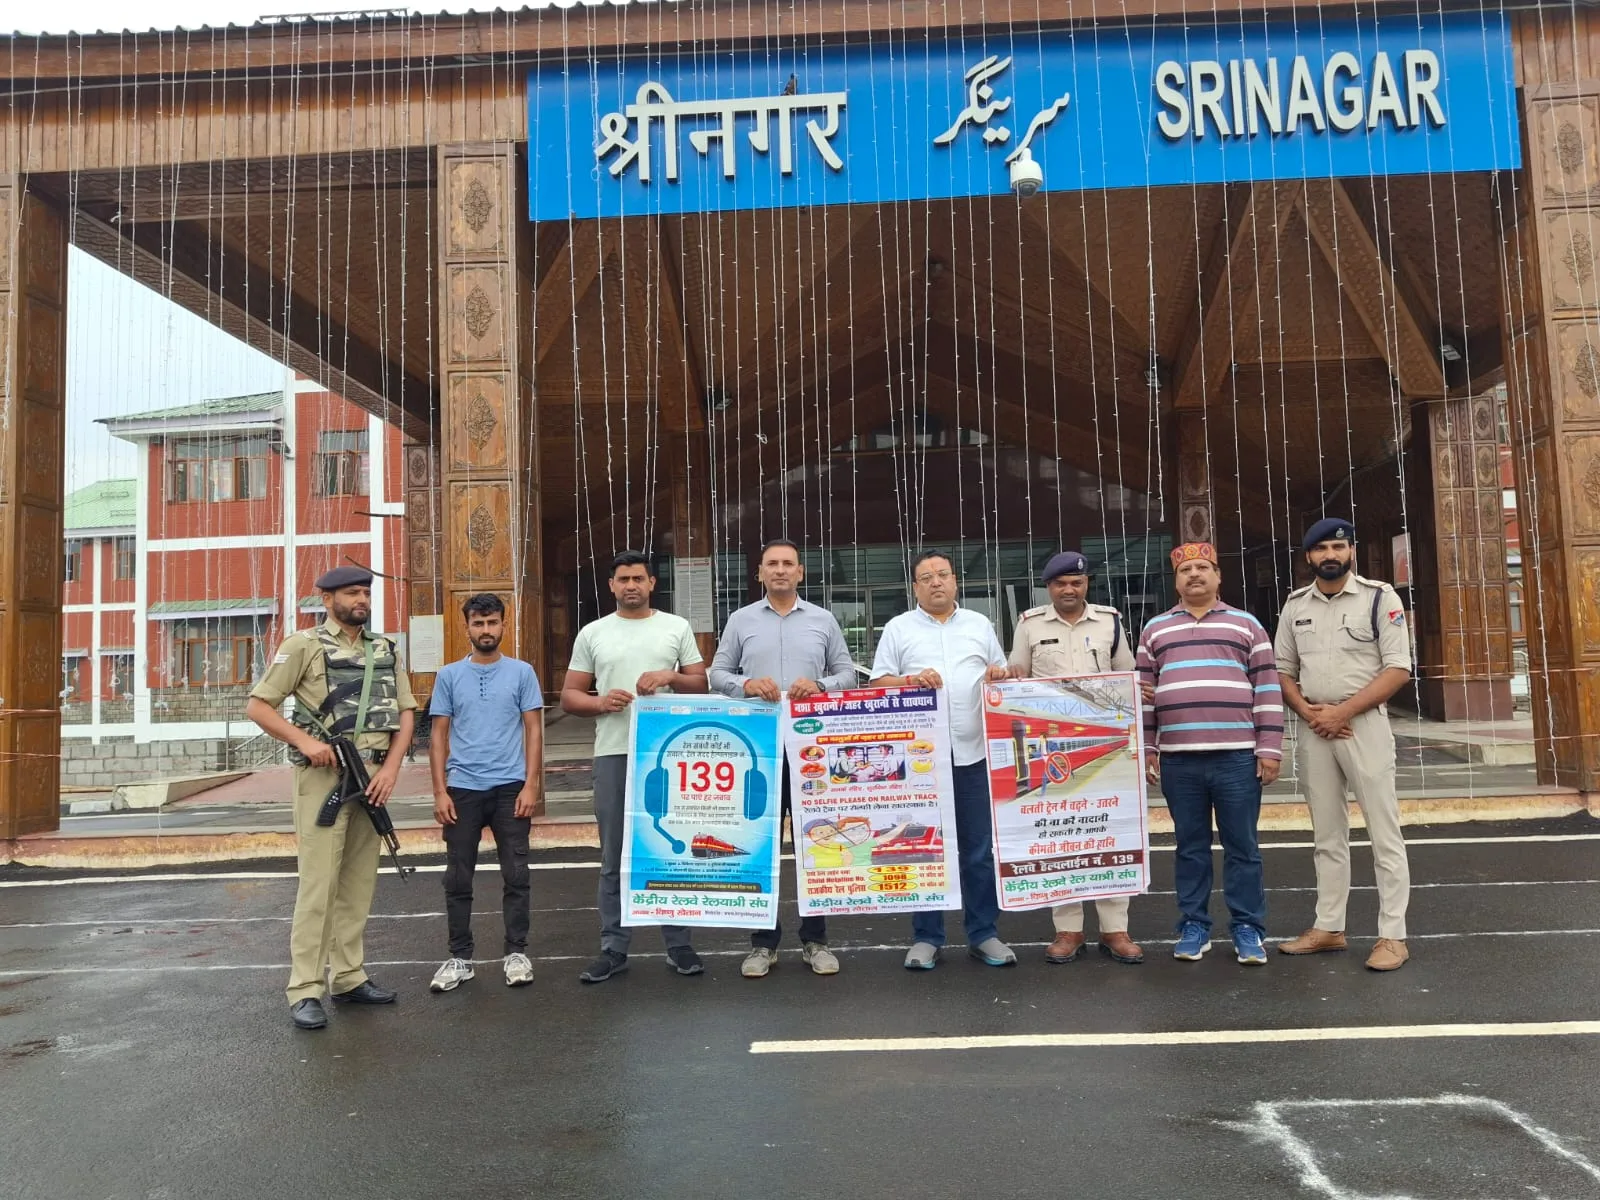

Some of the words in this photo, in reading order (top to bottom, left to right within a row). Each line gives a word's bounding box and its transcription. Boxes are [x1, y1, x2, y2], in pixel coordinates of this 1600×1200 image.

[1155, 49, 1447, 141] SRINAGAR
[933, 55, 1070, 162] سرینگر
[596, 81, 847, 184] श्रीनगर
[845, 700, 861, 711] जहर
[892, 696, 900, 706] से
[903, 695, 934, 707] सावधान
[723, 741, 731, 749] भी
[677, 761, 735, 793] 139
[840, 796, 866, 804] PLEASE
[1020, 801, 1044, 814] चलती
[1046, 801, 1057, 815] ट्रेन
[1096, 796, 1119, 808] उतरने
[1034, 818, 1046, 828] की
[1049, 818, 1060, 826] ना
[1078, 812, 1109, 824] नादानी
[1038, 830, 1047, 839] हो
[1049, 827, 1073, 837] सकती
[1075, 827, 1081, 836] है
[1028, 842, 1056, 855] कीमती
[1059, 840, 1081, 852] जीवन
[1083, 838, 1095, 849] की
[1097, 836, 1115, 850] हानि
[1010, 862, 1036, 875] रेलवे
[1112, 854, 1134, 864] 139
[835, 884, 845, 893] रेल
[848, 883, 866, 895] पुलिस
[878, 882, 907, 890] 1512
[1005, 879, 1038, 893] केंद्रीय
[1043, 876, 1067, 888] रेलवे
[1070, 874, 1086, 885] रेल
[1117, 868, 1137, 880] संघ
[632, 893, 668, 906] केंद्रीय
[672, 894, 699, 906] रेलवे
[701, 895, 746, 908] रेलयात्री
[749, 896, 768, 909] संघ
[846, 896, 872, 905] रेलवे
[925, 893, 944, 902] संघ
